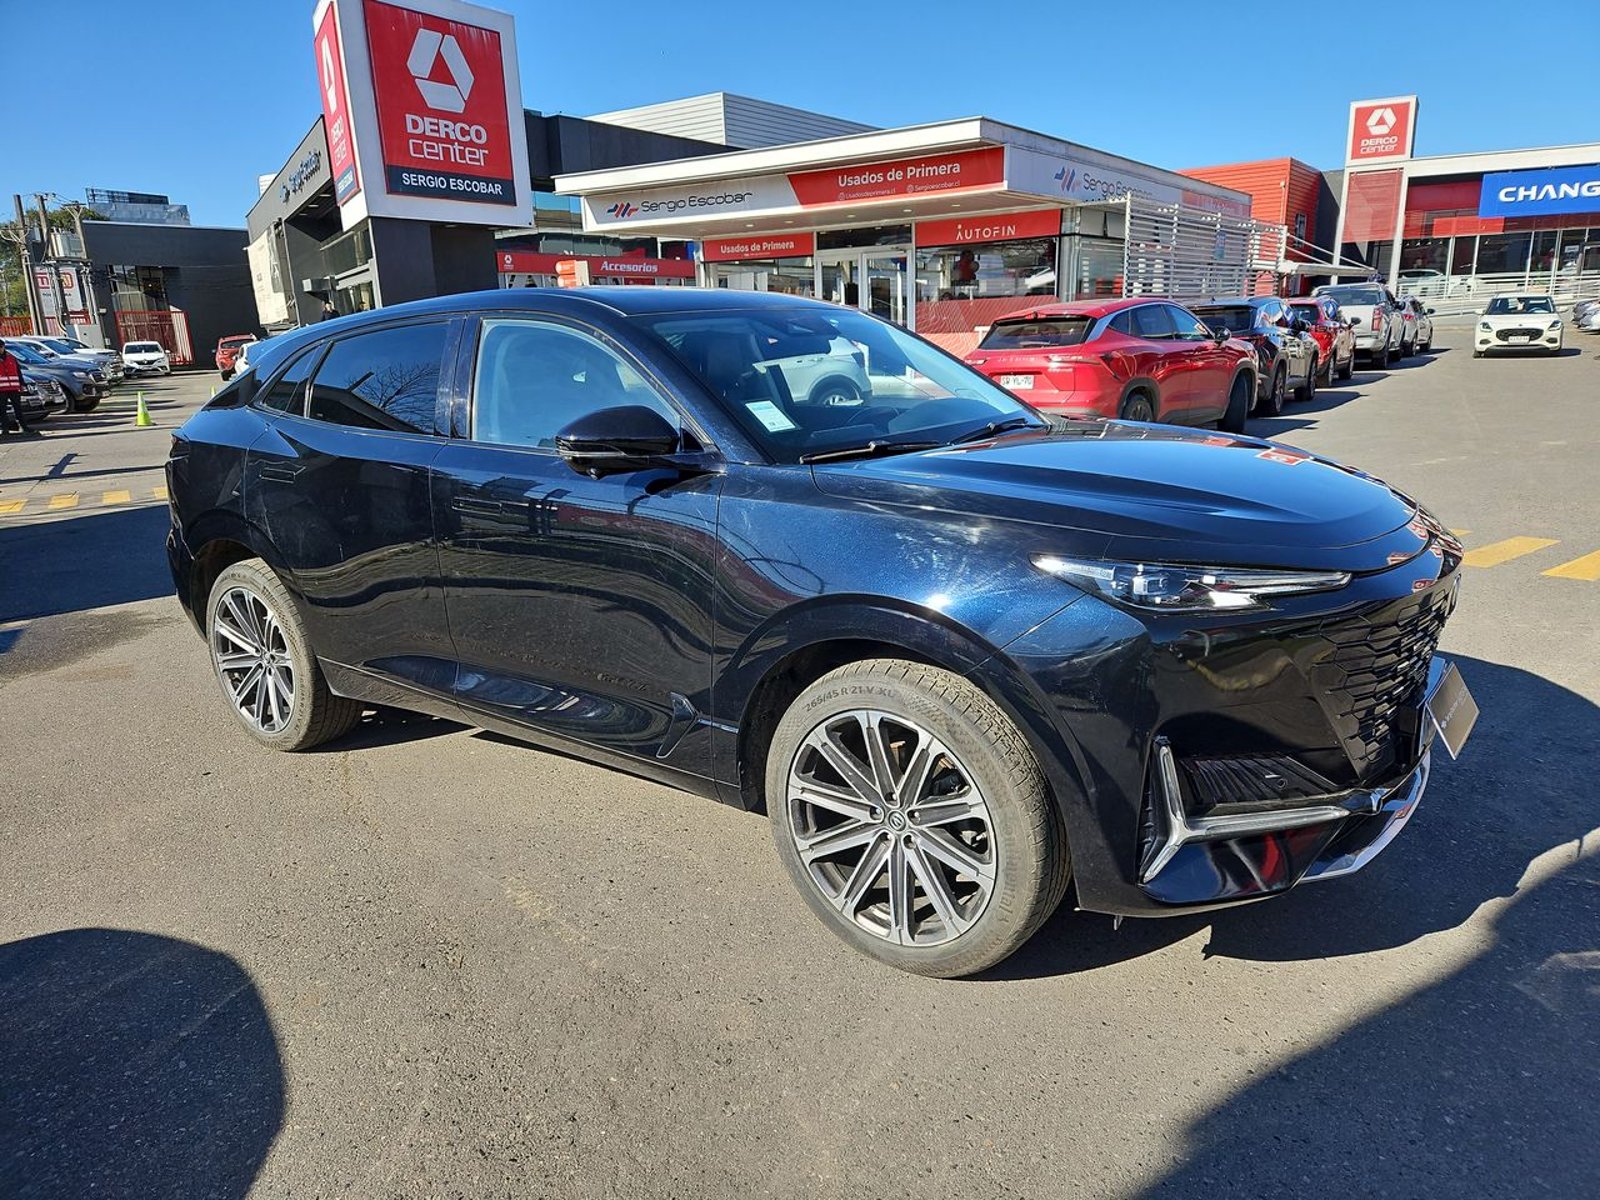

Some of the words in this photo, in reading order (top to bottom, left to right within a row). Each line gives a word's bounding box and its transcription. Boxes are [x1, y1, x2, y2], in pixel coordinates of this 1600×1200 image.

[405, 113, 488, 145] DERCO
[1360, 135, 1399, 147] DERCO
[1360, 143, 1398, 155] center
[408, 138, 489, 167] center
[838, 171, 884, 188] Usados
[886, 167, 904, 182] de
[906, 162, 961, 179] Primera
[401, 173, 448, 190] SERGIO
[449, 178, 504, 196] ESCOBAR
[1498, 180, 1600, 203] CHANG
[688, 192, 753, 207] Escobar
[955, 224, 1017, 241] AUTOFIN
[720, 245, 750, 255] Usados
[750, 242, 761, 252] de
[762, 240, 795, 251] Primera
[600, 260, 658, 273] Accesorios
